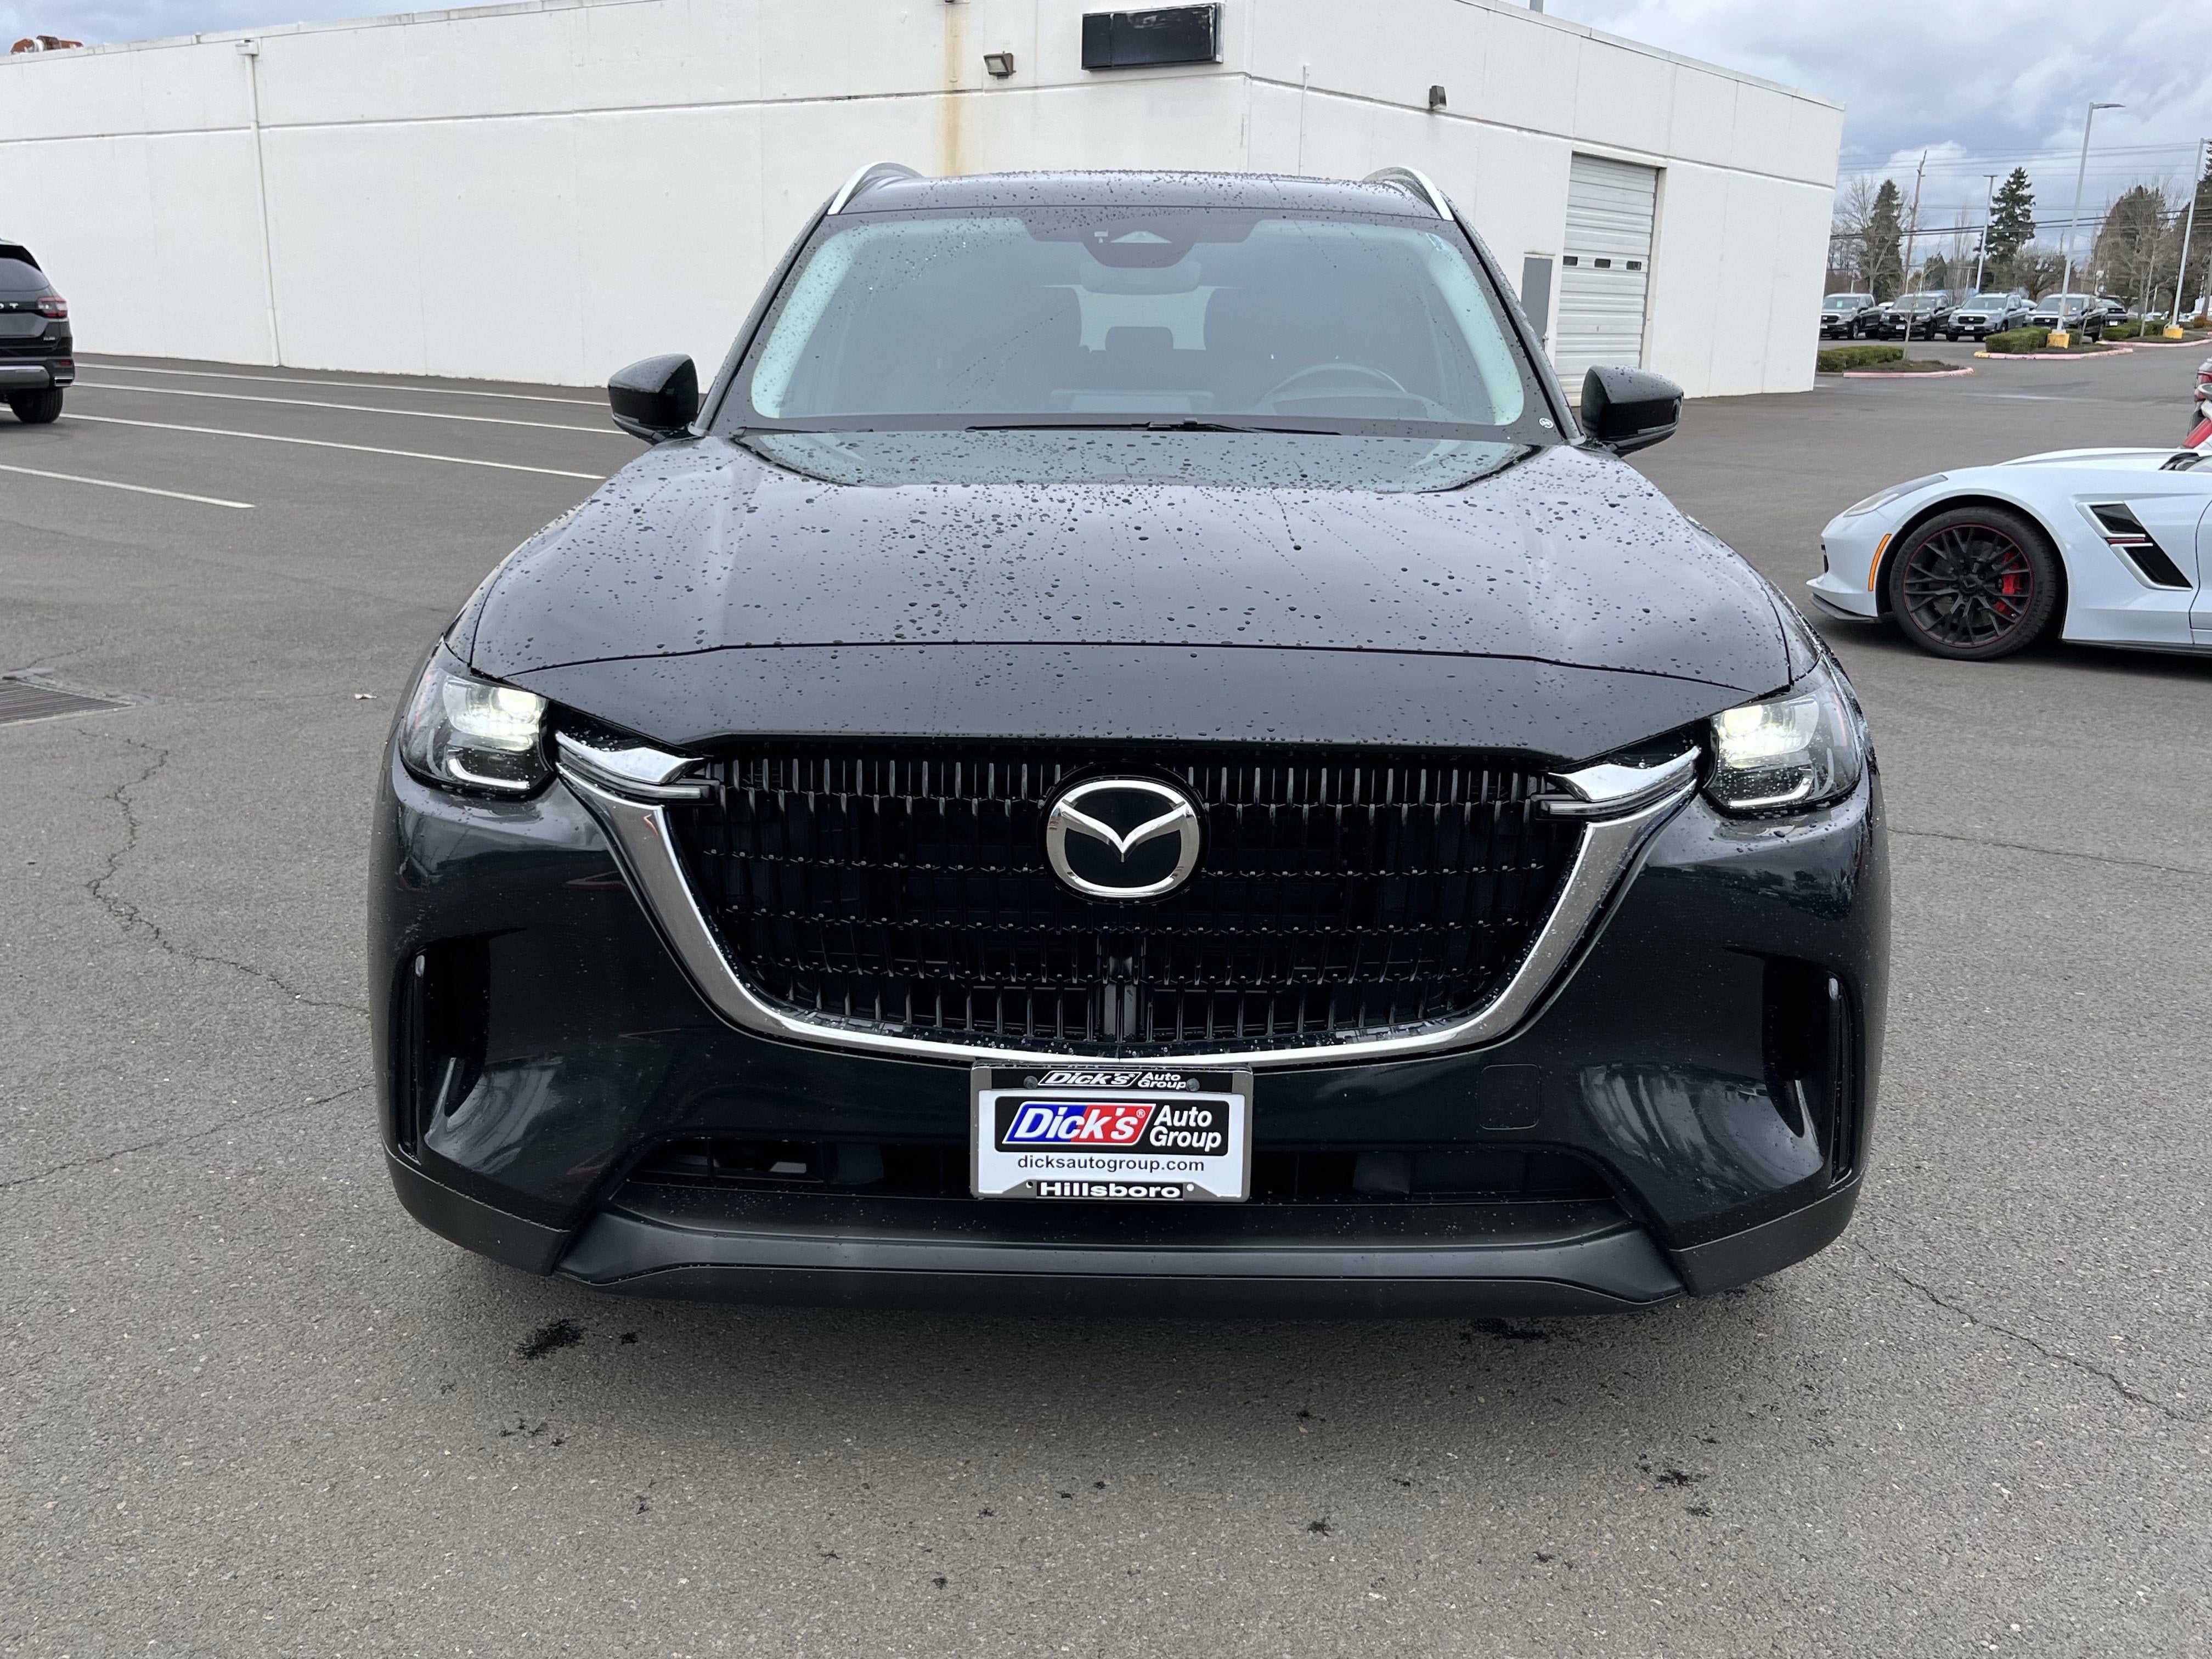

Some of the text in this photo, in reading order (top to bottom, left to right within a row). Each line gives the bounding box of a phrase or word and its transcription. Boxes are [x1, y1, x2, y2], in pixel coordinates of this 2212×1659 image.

[1045, 1071, 1181, 1085] Dick's Auto
[1137, 1079, 1186, 1090] Group
[1014, 1105, 1212, 1140] Dick's Auto
[1149, 1126, 1221, 1152] Group
[1018, 1155, 1204, 1172] dicksautogroup.com
[1040, 1182, 1181, 1198] Hillsboro
